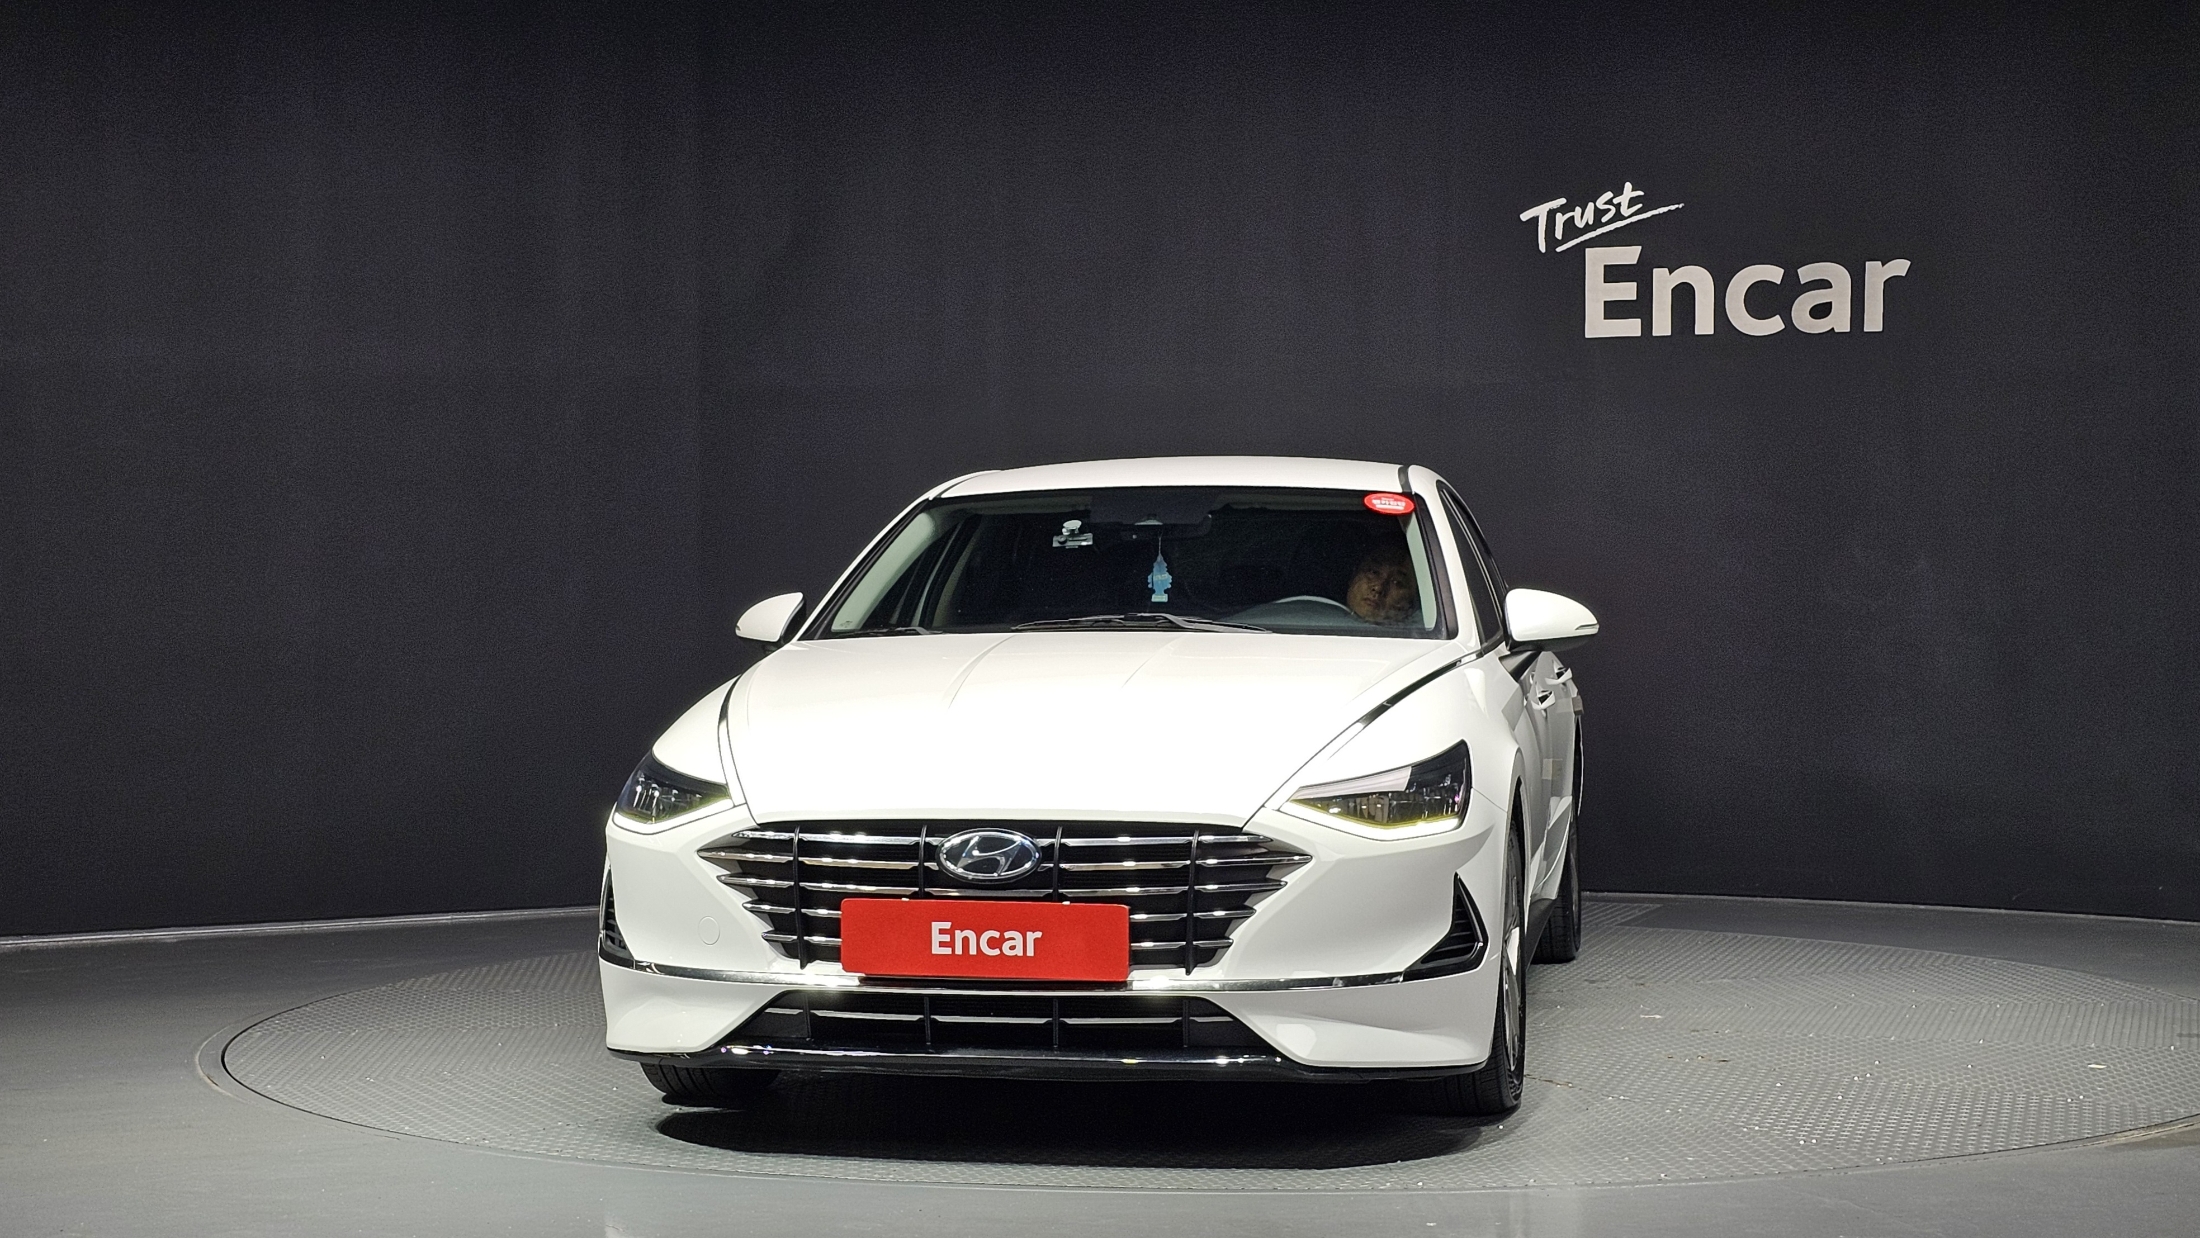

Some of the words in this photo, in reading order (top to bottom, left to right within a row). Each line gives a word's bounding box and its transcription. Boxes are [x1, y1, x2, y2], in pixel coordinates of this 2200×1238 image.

[1519, 181, 1645, 254] Trust
[1584, 245, 1912, 339] Encar
[931, 921, 1043, 957] Encar
